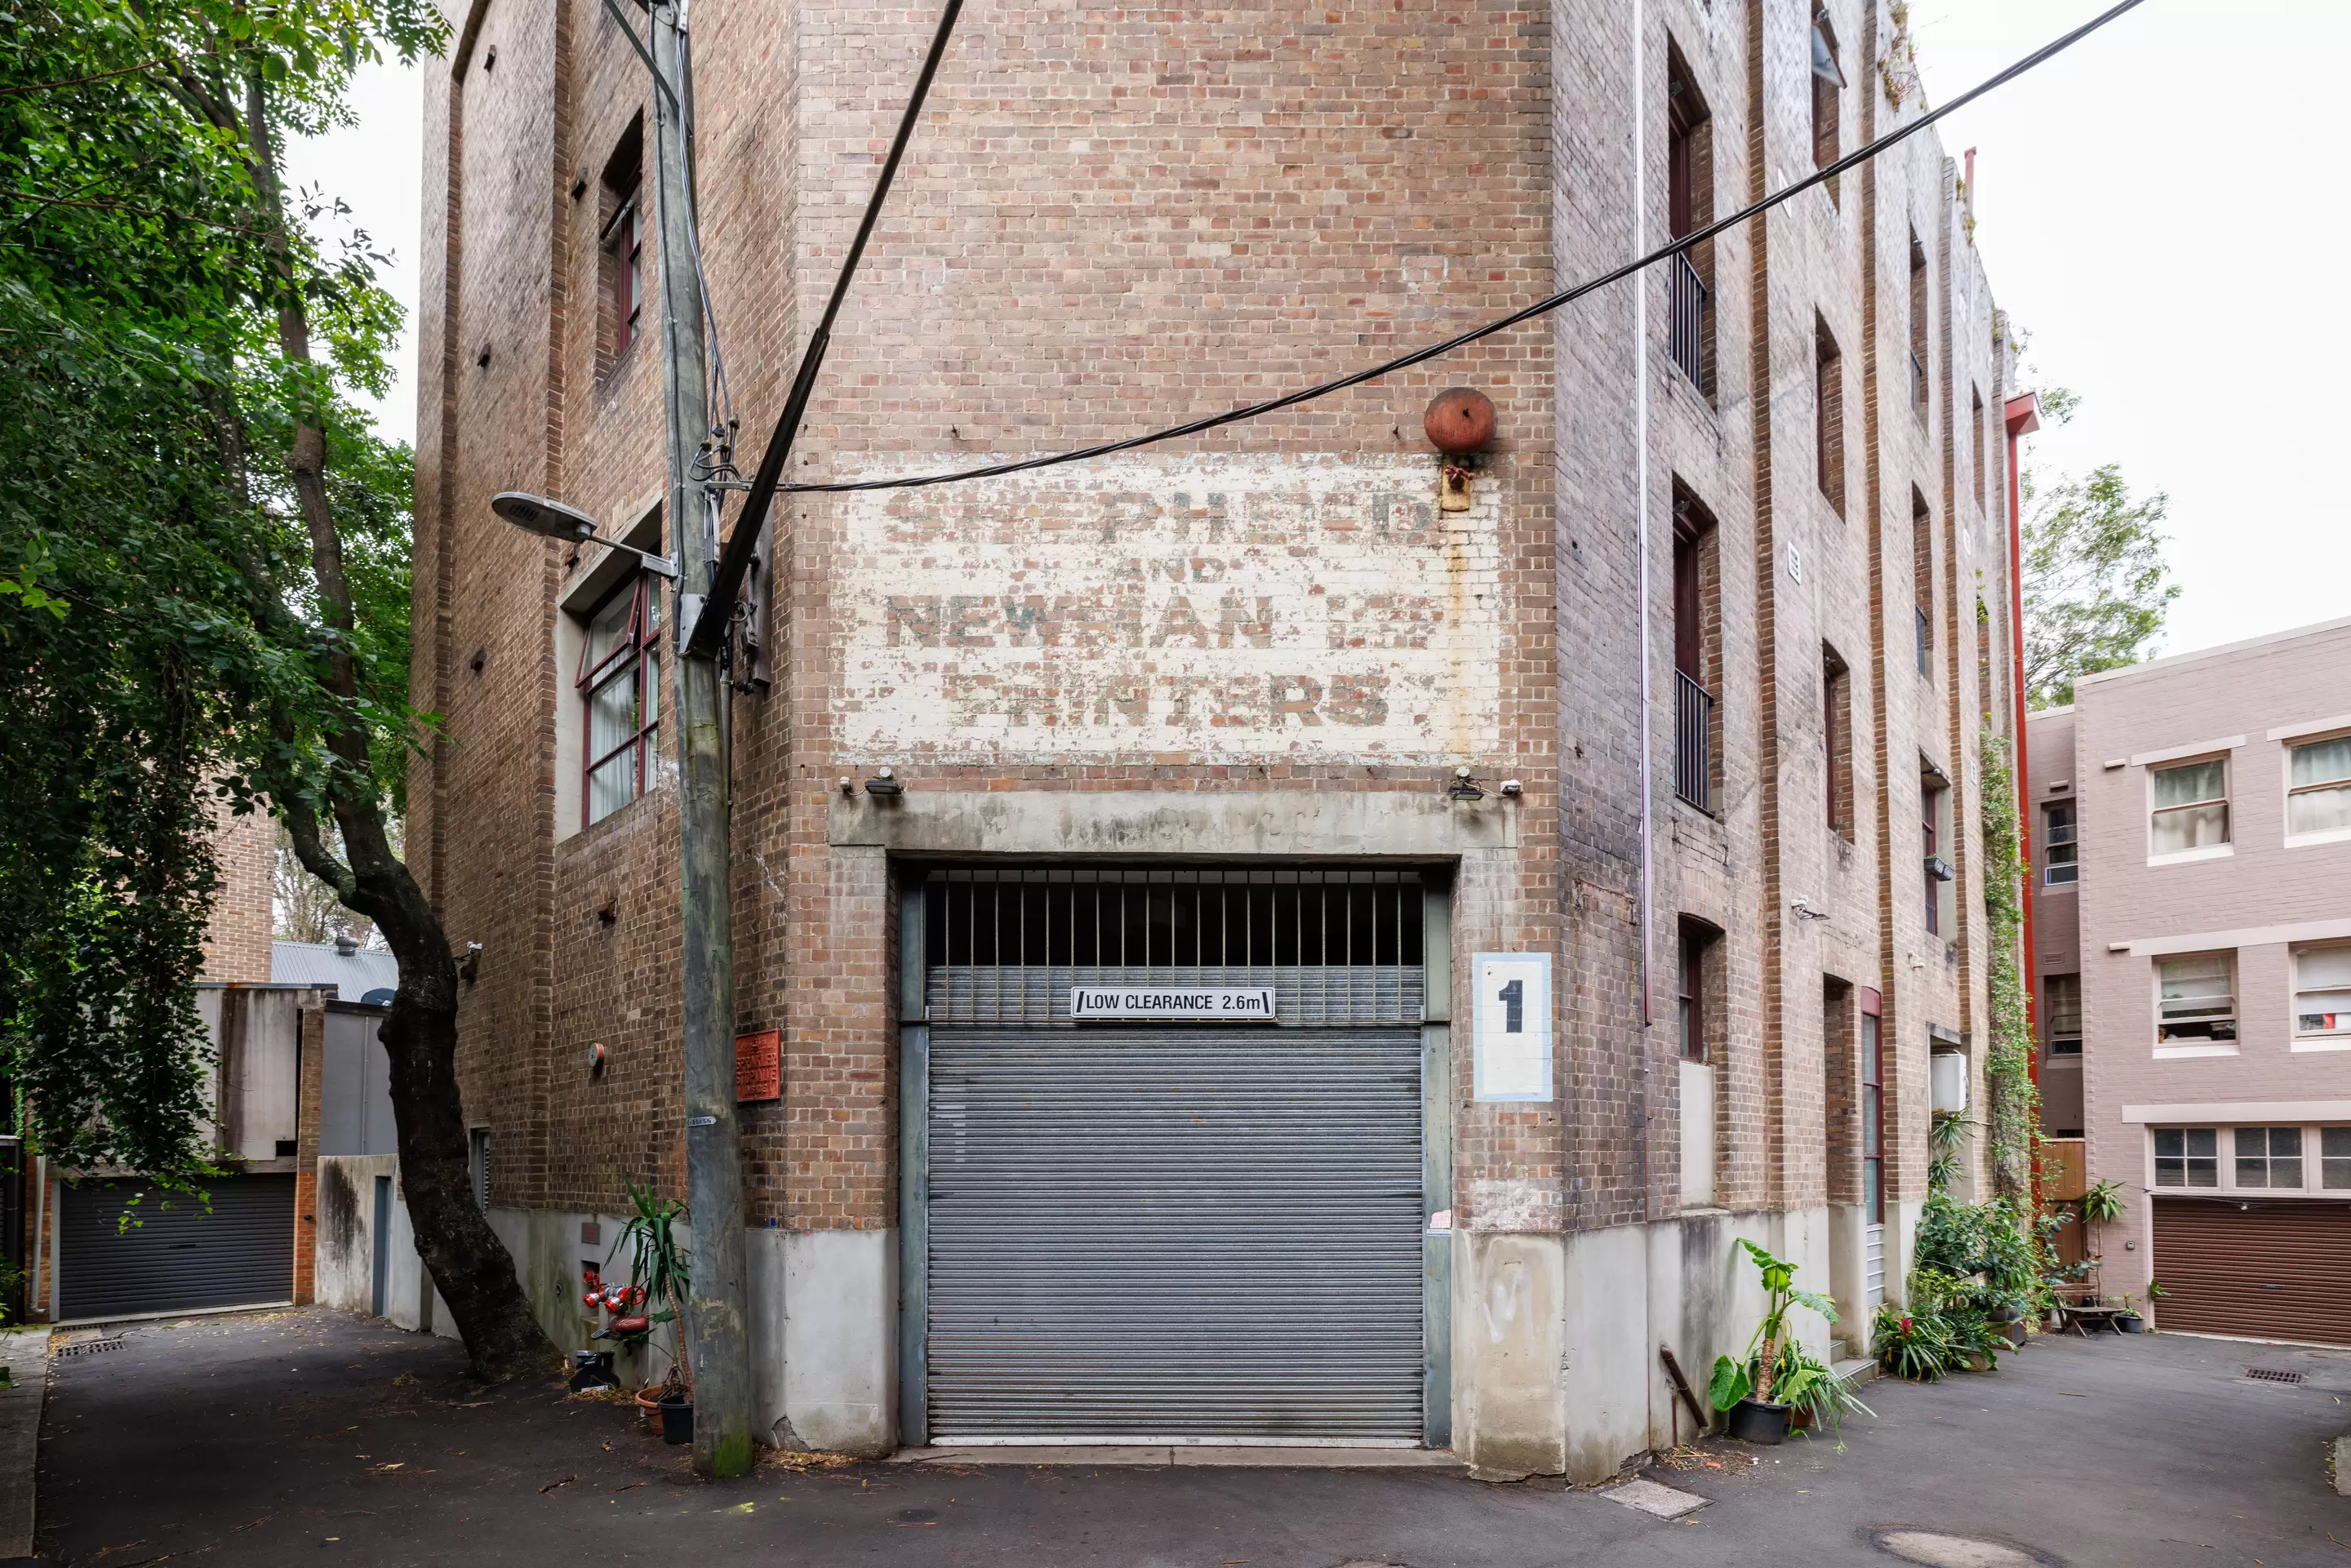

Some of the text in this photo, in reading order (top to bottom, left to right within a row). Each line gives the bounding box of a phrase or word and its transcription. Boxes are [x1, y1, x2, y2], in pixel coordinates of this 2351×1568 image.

[1112, 557, 1225, 583] AND
[885, 595, 1273, 647] NEWMAN
[1087, 995, 1260, 1010] LOW CLEARANCE 2.6m
[1499, 979, 1522, 1033] 1
[736, 1053, 777, 1071] SPRINKLER
